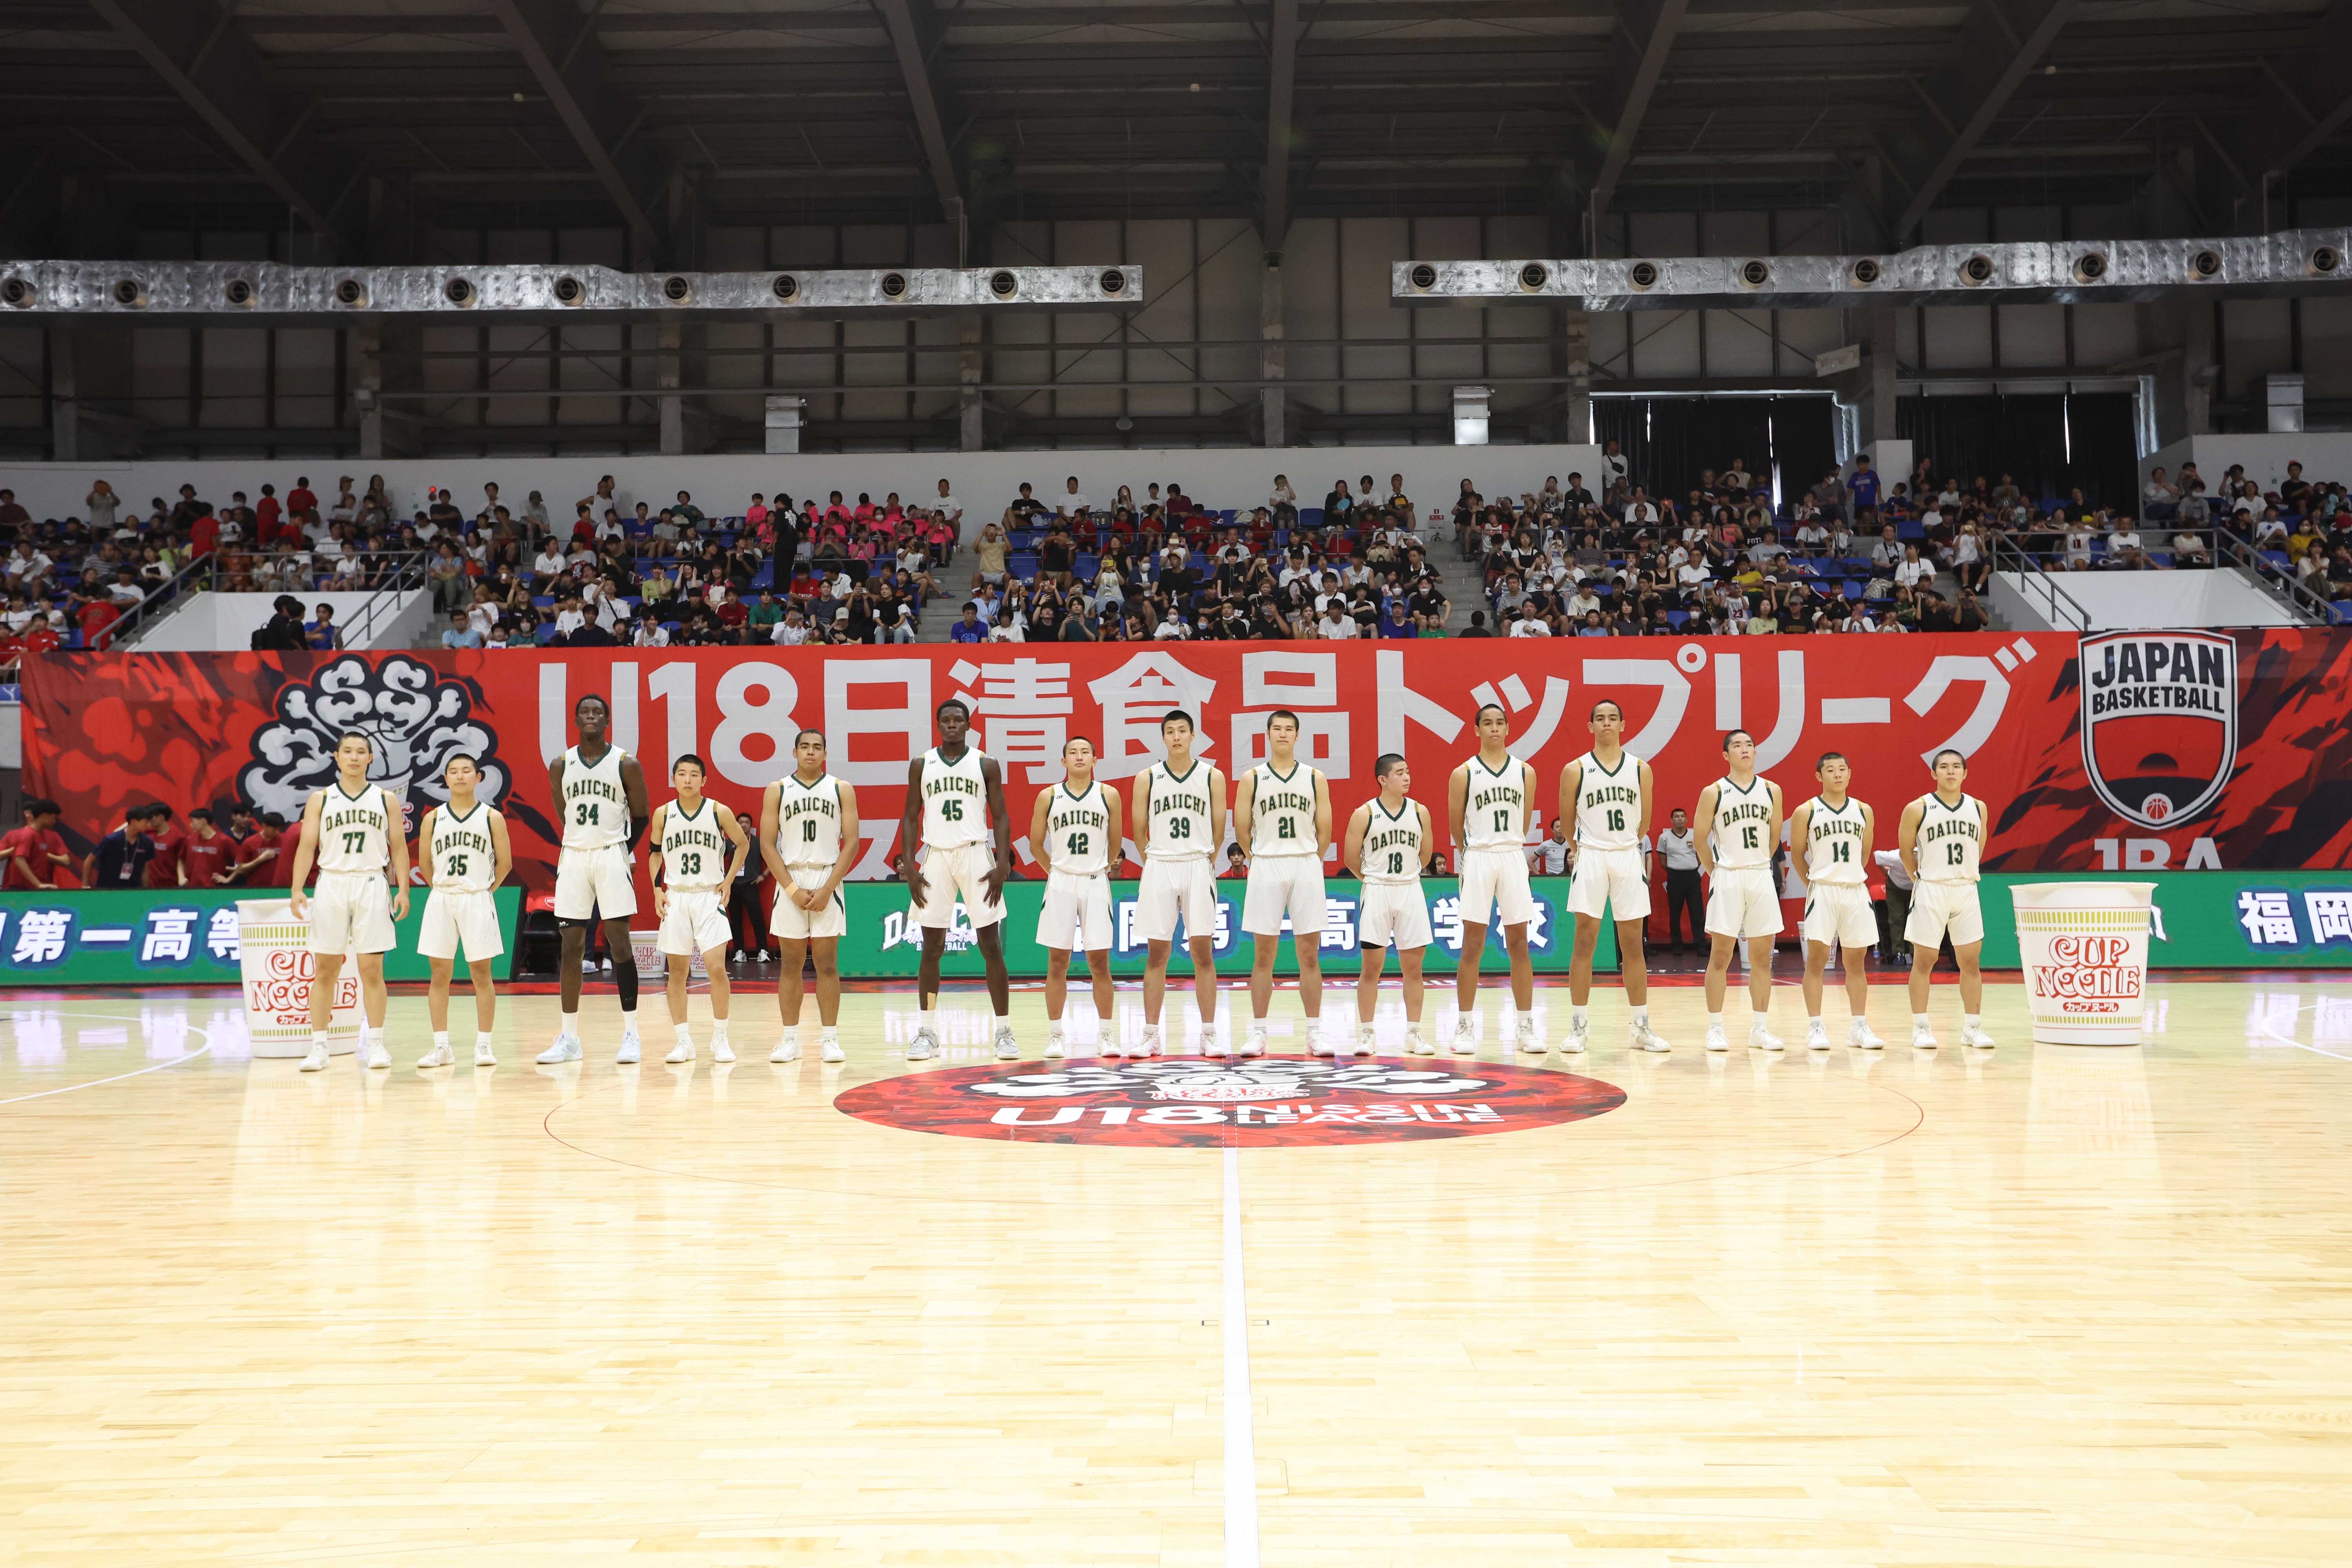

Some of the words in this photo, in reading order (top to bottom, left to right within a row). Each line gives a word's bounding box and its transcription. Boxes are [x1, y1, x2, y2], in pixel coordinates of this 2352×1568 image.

[2092, 642, 2225, 688] JAPAN
[2092, 686, 2225, 715] BASKETBALL
[926, 777, 979, 798] DAIICHI
[1475, 786, 1522, 811] DAIICHI
[576, 803, 599, 826] 34
[784, 797, 835, 821] DAIICHI
[941, 799, 963, 822] 45
[1154, 793, 1206, 816] DAIICHI
[1259, 793, 1310, 816] DAIICHI
[325, 809, 383, 831] DAIICHI
[802, 820, 817, 842] 10
[1053, 810, 1104, 832] DAIICHI
[1169, 817, 1190, 839] 39
[1278, 816, 1296, 838] 21
[1494, 809, 1508, 833] 17
[1606, 809, 1625, 831] 16
[1926, 820, 1978, 842] DAIICHI
[342, 831, 365, 854] 77
[435, 831, 487, 855] DAIICHI
[666, 829, 717, 853] DAIICHI
[1067, 833, 1089, 855] 42
[1742, 826, 1759, 849] 15
[1387, 852, 1403, 874] 18
[1832, 841, 1849, 863] 14
[1947, 843, 1963, 865] 13
[447, 854, 468, 877] 35
[681, 853, 701, 875] 33
[2238, 891, 2352, 943] 福岡
[2049, 935, 2129, 968] CUP
[265, 950, 347, 981] CU
[2033, 965, 2140, 999] NOODLE
[991, 1105, 1229, 1125] U18
[1236, 1104, 1496, 1114] NISSIN
[1236, 1113, 1505, 1124] LEAGUE
